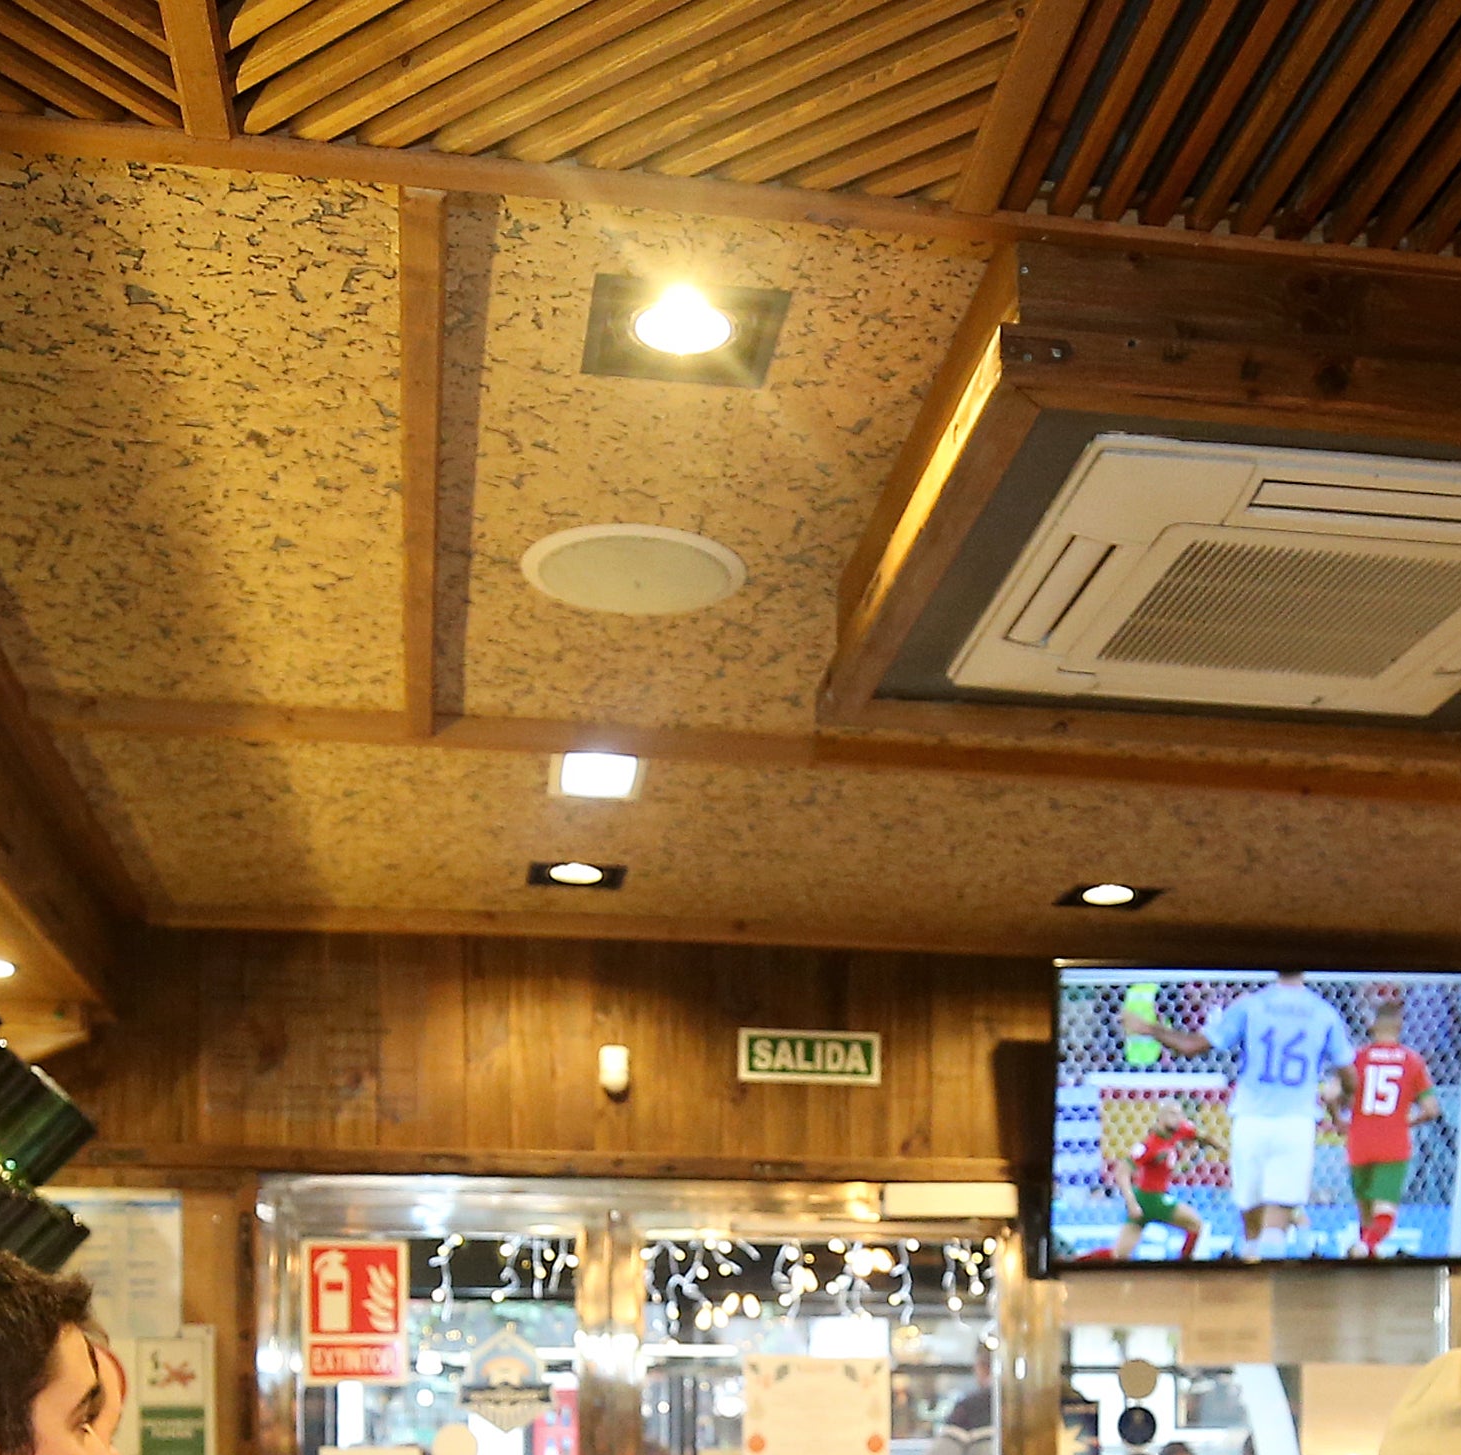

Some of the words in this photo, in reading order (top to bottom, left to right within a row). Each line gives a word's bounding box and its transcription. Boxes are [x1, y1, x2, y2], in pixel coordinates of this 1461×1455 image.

[752, 1038, 869, 1073] SALIDA
[1258, 1026, 1308, 1086] 16
[1361, 1064, 1404, 1116] 15
[311, 1346, 397, 1371] EXTINTOR
